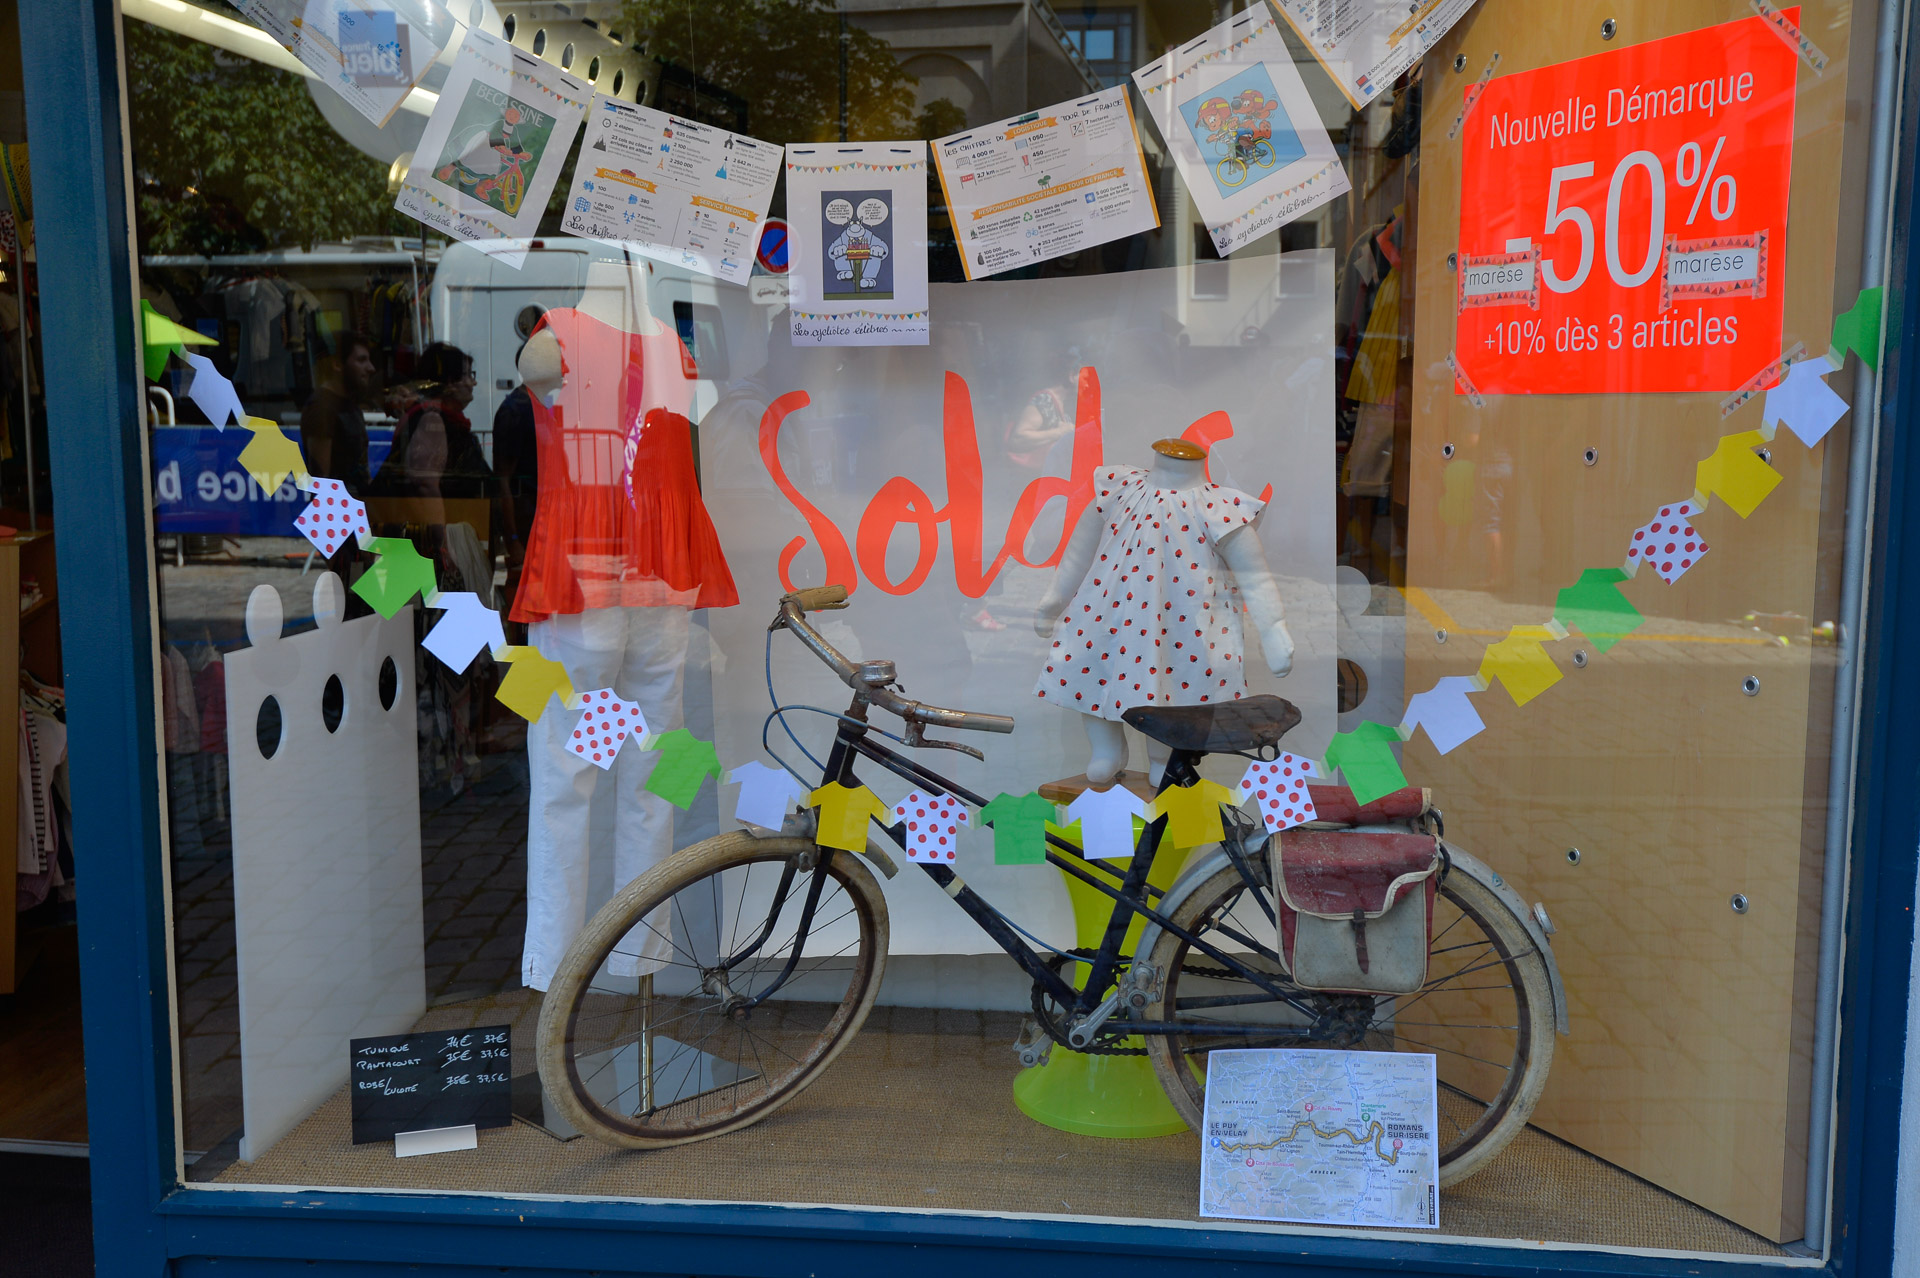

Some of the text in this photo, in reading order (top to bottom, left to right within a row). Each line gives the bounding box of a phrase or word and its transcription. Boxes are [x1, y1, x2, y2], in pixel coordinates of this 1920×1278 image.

[1094, 98, 1125, 113] FRANCE
[1490, 71, 1754, 149] Nouvelle Démarque
[1013, 120, 1048, 135] LOGISTIQUE
[1031, 149, 1044, 157] 450
[604, 170, 649, 188] ORGANISATION
[1067, 179, 1084, 189] TOUR
[1094, 169, 1118, 180] FRANCE
[699, 198, 724, 210] SERVICE
[1506, 136, 1738, 294] -50%
[1674, 252, 1744, 274] marèse
[1484, 307, 1739, 355] +10% dès 3 articles
[358, 1043, 410, 1056] TUNIQUE
[483, 1032, 508, 1044] 37€
[356, 1058, 421, 1070] PANTACOURT
[480, 1049, 510, 1059] 37,5€
[476, 1073, 509, 1084] 37,5€
